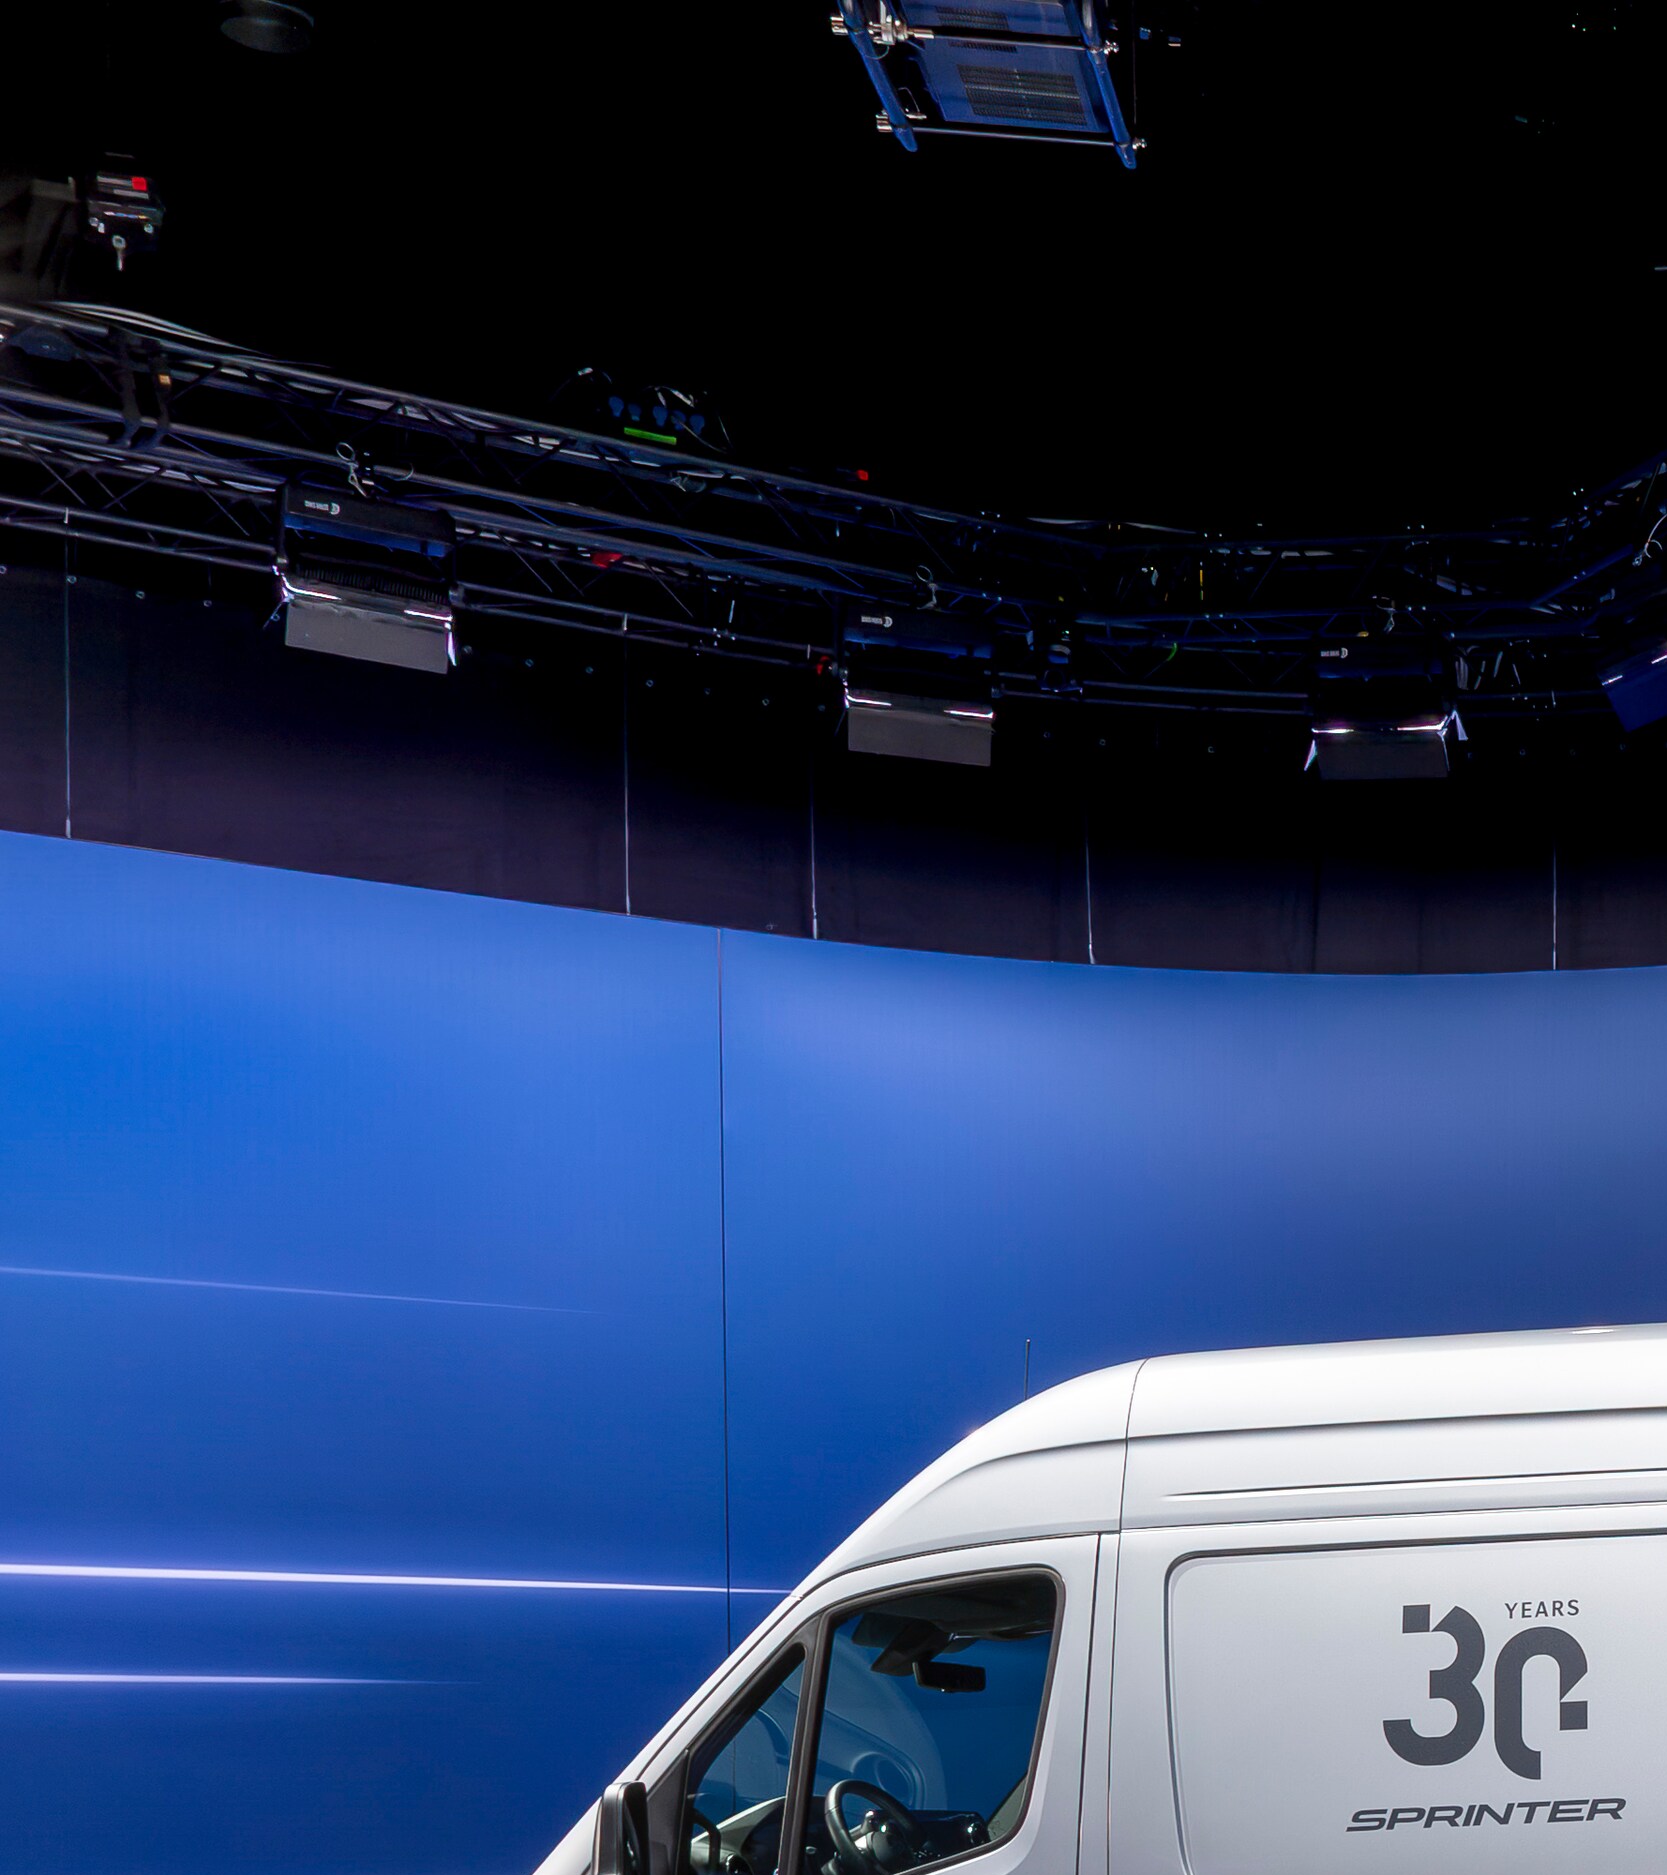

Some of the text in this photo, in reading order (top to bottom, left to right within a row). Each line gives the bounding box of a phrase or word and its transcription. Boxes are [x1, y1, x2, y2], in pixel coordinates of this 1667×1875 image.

[1504, 1599, 1580, 1619] YEARS
[1382, 1603, 1589, 1780] 30
[1345, 1797, 1627, 1832] SPRINTER
